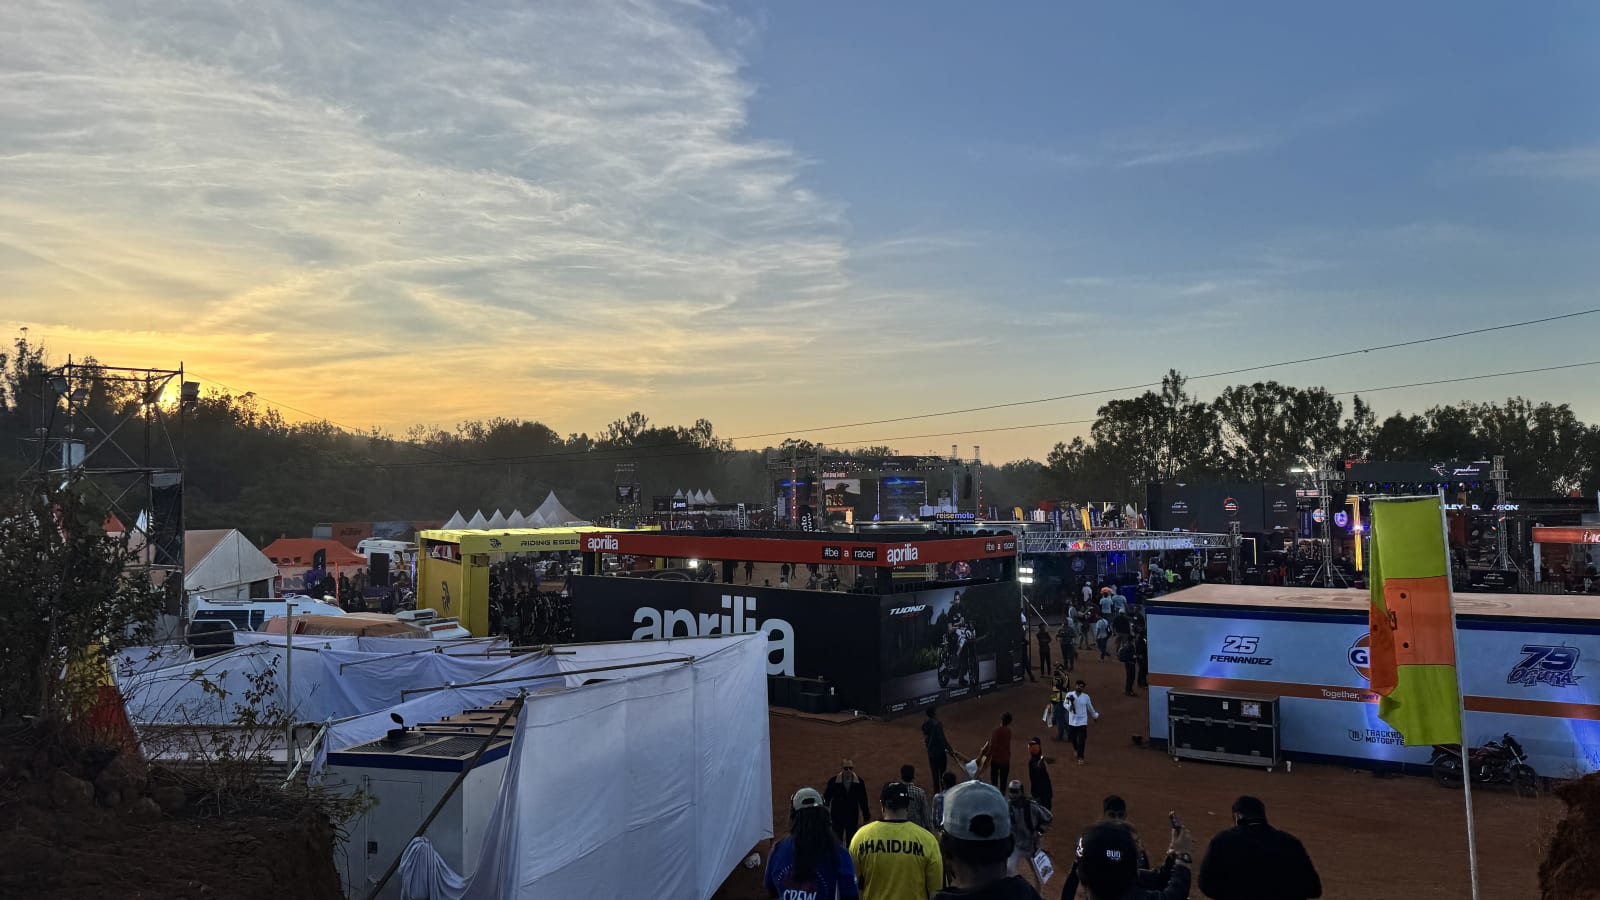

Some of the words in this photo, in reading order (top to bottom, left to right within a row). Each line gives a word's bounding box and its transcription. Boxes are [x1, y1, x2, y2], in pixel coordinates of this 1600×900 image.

[587, 534, 619, 551] aprilia
[1095, 540, 1111, 550] Red
[1112, 540, 1127, 550] Bull
[824, 548, 839, 558] #be
[854, 550, 875, 559] racer
[886, 543, 918, 563] aprilia
[890, 604, 926, 616] TUONO
[1222, 635, 1260, 654] 25
[1210, 655, 1273, 666] FERNANDEZ
[1512, 645, 1580, 671] 79
[1321, 688, 1360, 701] Together,
[859, 839, 924, 857] #HAIDUM
